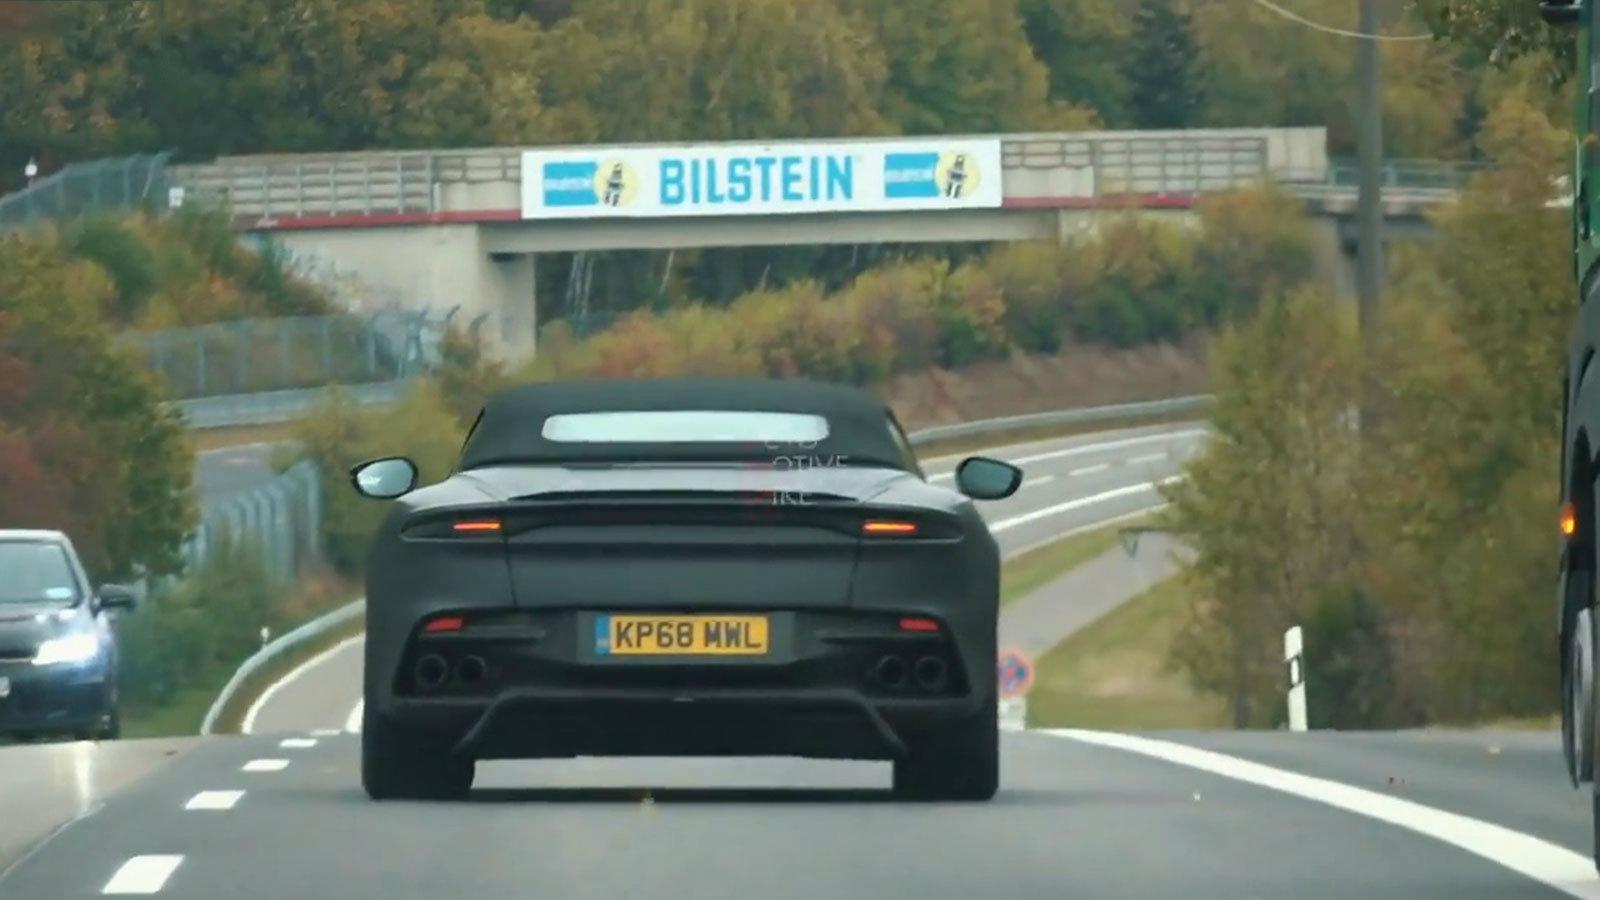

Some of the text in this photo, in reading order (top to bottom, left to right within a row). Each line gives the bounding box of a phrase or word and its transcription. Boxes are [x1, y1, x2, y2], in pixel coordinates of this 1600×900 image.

[660, 156, 853, 204] BILSTEIN
[615, 621, 762, 649] KP68 MWL
